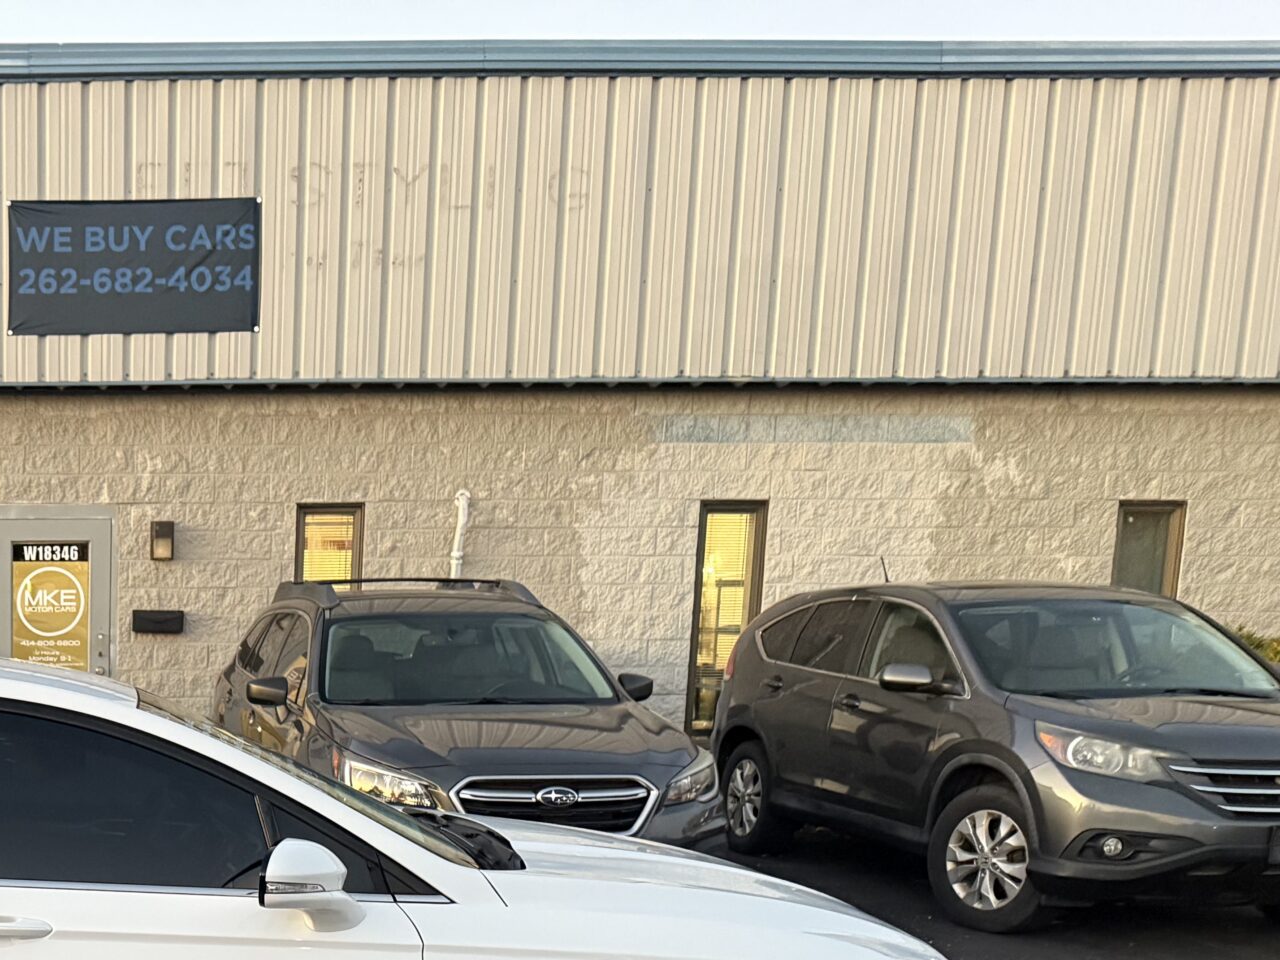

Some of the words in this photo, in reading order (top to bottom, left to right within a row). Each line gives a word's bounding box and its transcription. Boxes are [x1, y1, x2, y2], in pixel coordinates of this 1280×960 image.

[16, 226, 72, 253] WE
[84, 225, 154, 252] BUY
[165, 223, 256, 250] CARS
[18, 265, 254, 294] 262-682-4034
[23, 545, 79, 560] W18346
[24, 589, 77, 606] MKE
